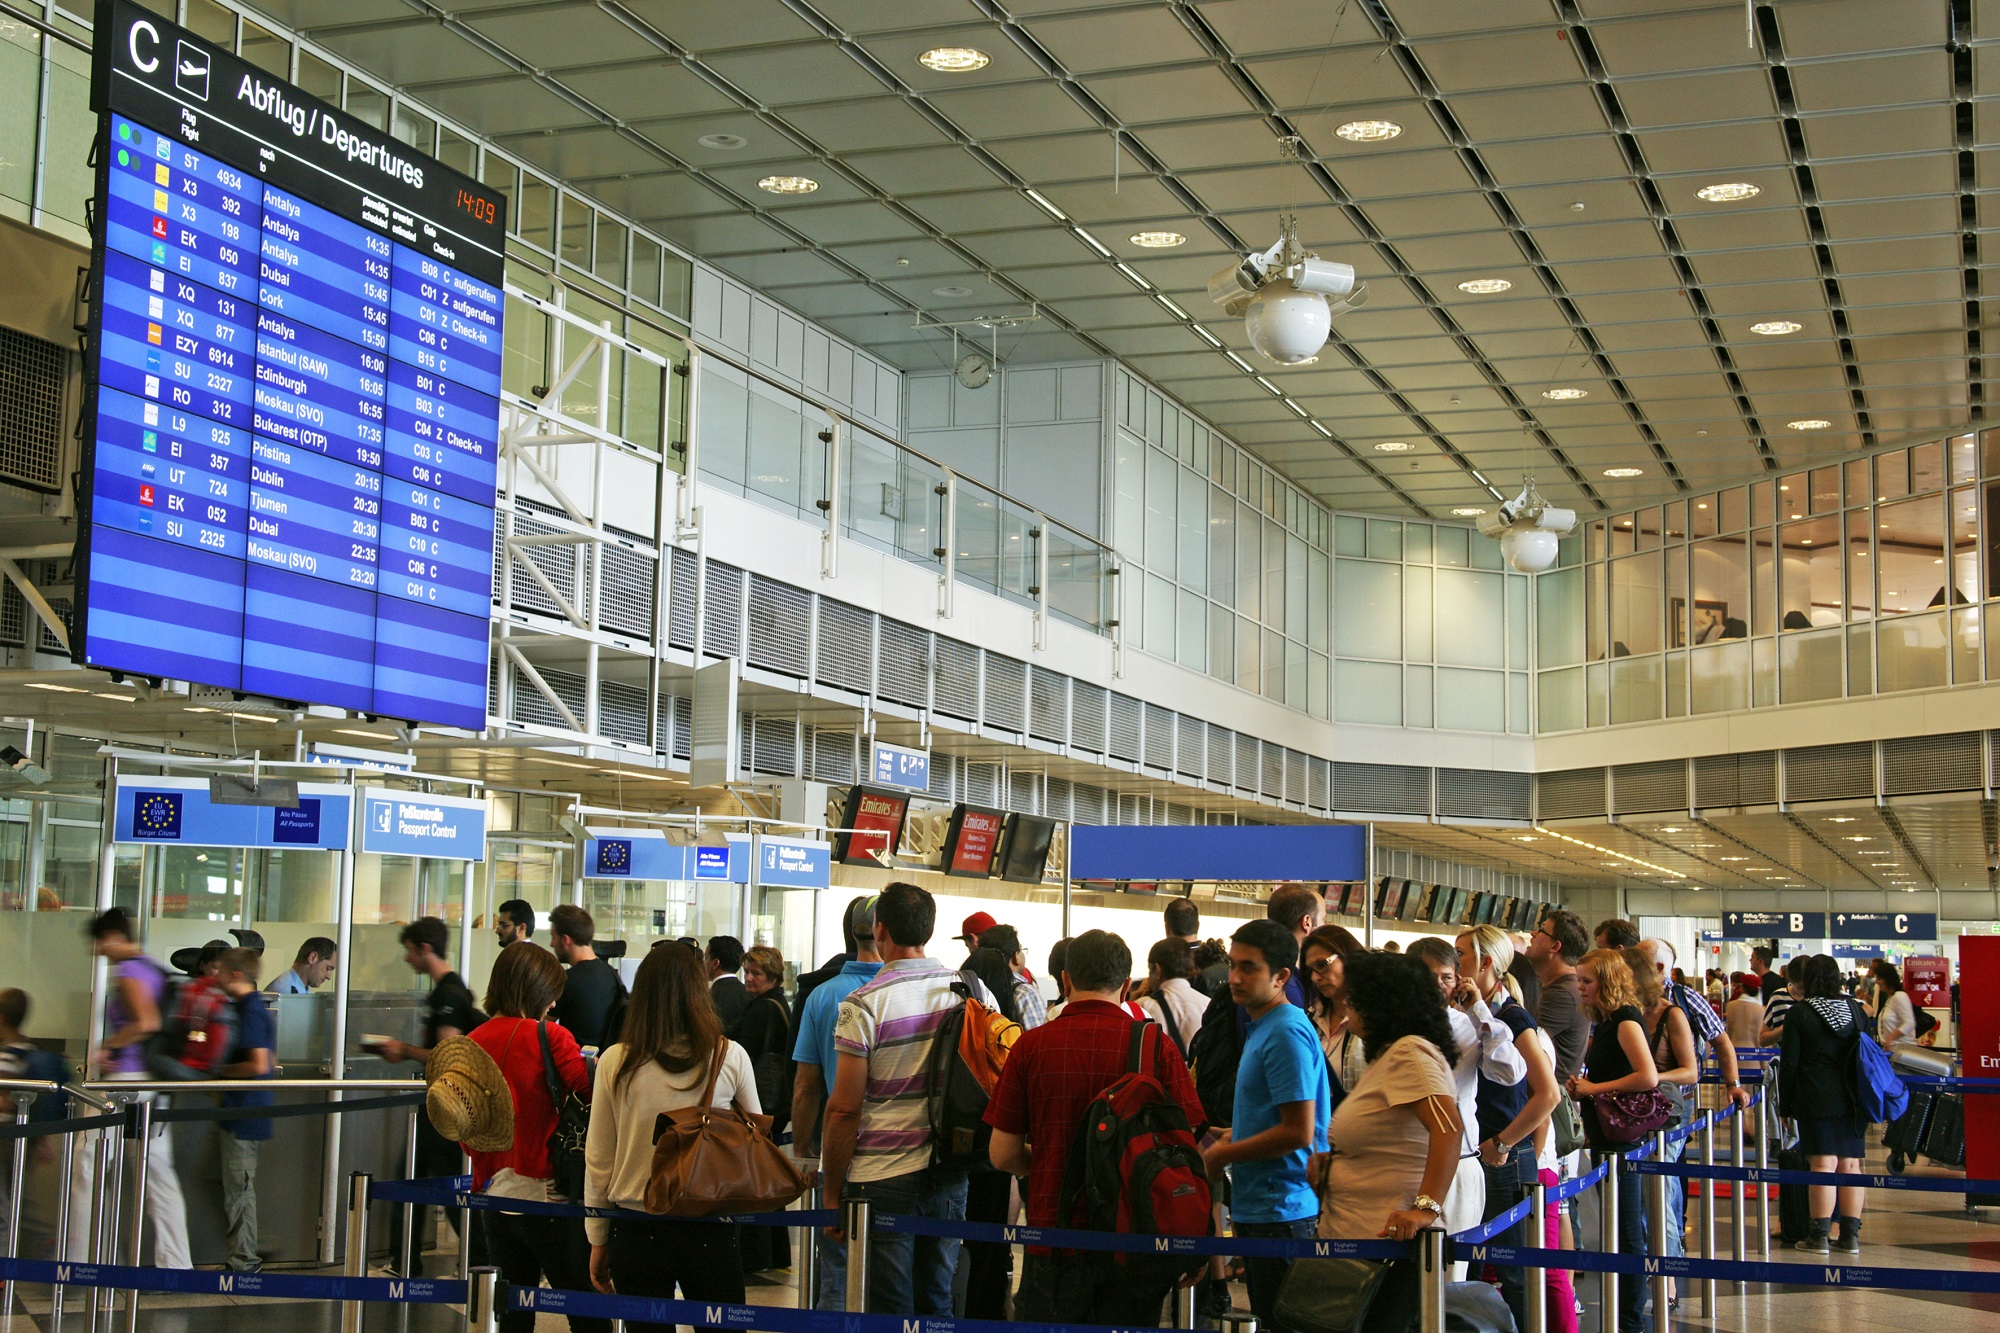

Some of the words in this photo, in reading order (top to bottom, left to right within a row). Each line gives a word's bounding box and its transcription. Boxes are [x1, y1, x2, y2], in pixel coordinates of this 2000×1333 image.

[130, 20, 159, 72] C
[182, 108, 196, 126] Flug
[181, 124, 199, 141] Flight
[238, 73, 305, 136] Abflug
[320, 112, 423, 190] Departures
[260, 148, 275, 161] nach
[260, 161, 266, 172] to
[456, 189, 495, 224] 14:09
[184, 153, 199, 170] ST
[217, 169, 241, 190] 4934
[264, 190, 300, 216] Antalya
[366, 236, 389, 256] 14:35
[422, 261, 438, 278] B08
[444, 271, 450, 283] C
[454, 278, 496, 304] aufgerufen
[183, 178, 197, 196] X3
[222, 196, 240, 215] 392
[263, 215, 299, 241] Antalya
[365, 259, 388, 279] 14:35
[421, 284, 436, 300] C01
[442, 293, 448, 305] Z
[453, 300, 495, 325] aufgerufen
[182, 204, 196, 222] X3
[221, 222, 239, 240] 198
[262, 240, 298, 266] Antalya
[364, 282, 387, 302] 15:45
[420, 306, 435, 322] C01
[441, 315, 448, 328] Z
[452, 320, 487, 344] Check-in
[181, 230, 196, 248] EK
[220, 247, 238, 265] 050
[261, 263, 289, 286] Dubai
[363, 306, 386, 325] 15:45
[419, 329, 435, 345] C06
[441, 338, 447, 350] C
[180, 256, 190, 272] EI
[219, 271, 237, 289] 837
[260, 288, 283, 308] Cork
[362, 329, 385, 348] 15:50
[418, 351, 434, 367] B15
[440, 359, 446, 372] C
[178, 283, 194, 302] XQ
[218, 299, 234, 317] 131
[258, 315, 294, 340] Antalya
[361, 354, 384, 372] 16:00
[417, 375, 432, 391] B01
[439, 383, 445, 395] C
[177, 309, 193, 328] XQ
[216, 324, 234, 342] 877
[257, 339, 296, 365] Istanbul
[299, 355, 328, 379] (SAW)
[360, 377, 383, 396] 16:05
[416, 397, 432, 414] B03
[438, 406, 444, 418] C
[176, 335, 198, 354] EZY
[209, 347, 233, 367] 6914
[256, 363, 306, 394] Edinburgh
[359, 401, 382, 419] 16:55
[415, 421, 431, 436] C04
[436, 428, 442, 440] Z
[447, 432, 482, 454] Check-in
[174, 362, 190, 379] SU
[207, 373, 232, 392] 2327
[255, 389, 294, 414] Moskau
[296, 403, 323, 426] (SVO)
[358, 424, 381, 442] 17:35
[414, 443, 430, 459] C03
[436, 451, 442, 463] C
[173, 387, 190, 404] RO
[213, 400, 231, 418] 312
[254, 413, 299, 440] Bukarest
[300, 429, 327, 452] (OTP)
[357, 448, 380, 466] 19:50
[413, 466, 429, 482] C06
[435, 473, 441, 485] C
[172, 416, 186, 432] L9
[212, 428, 230, 446] 925
[253, 441, 290, 464] Pristina
[355, 473, 378, 491] 20:15
[412, 491, 427, 506] C01
[433, 497, 440, 510] C
[171, 442, 182, 457] EI
[210, 454, 229, 470] 357
[252, 466, 283, 488] Dublin
[354, 497, 378, 514] 20:20
[411, 513, 426, 529] B03
[432, 520, 439, 532] C
[170, 468, 185, 484] UT
[209, 479, 227, 496] 724
[251, 491, 287, 514] Tjumen
[352, 520, 376, 538] 20:30
[409, 536, 426, 552] C10
[431, 542, 438, 555] C
[168, 494, 184, 512] EK
[208, 505, 226, 522] 052
[249, 517, 278, 536] Dubai
[351, 544, 376, 562] 22:35
[408, 560, 424, 575] C06
[430, 565, 437, 578] C
[167, 521, 182, 537] SU
[200, 529, 224, 548] 2325
[248, 542, 286, 564] Moskau
[289, 552, 316, 574] (SVO)
[350, 568, 374, 585] 23:20
[407, 582, 423, 597] C01
[429, 588, 436, 600] C
[901, 755, 906, 773] C
[861, 797, 891, 815] Emirates
[399, 820, 430, 838] Passport
[432, 824, 456, 838] Control
[964, 814, 989, 830] Emirates
[1790, 914, 1804, 932] B
[1895, 914, 1908, 933] C
[219, 1275, 233, 1291] M
[238, 1276, 262, 1284] Flughafen
[1825, 1268, 1840, 1282] M
[238, 1282, 260, 1290] München
[519, 1290, 534, 1307] M
[540, 1298, 564, 1306] München
[706, 1306, 722, 1324] M
[728, 1308, 755, 1316] Flughafen
[728, 1314, 753, 1323] München
